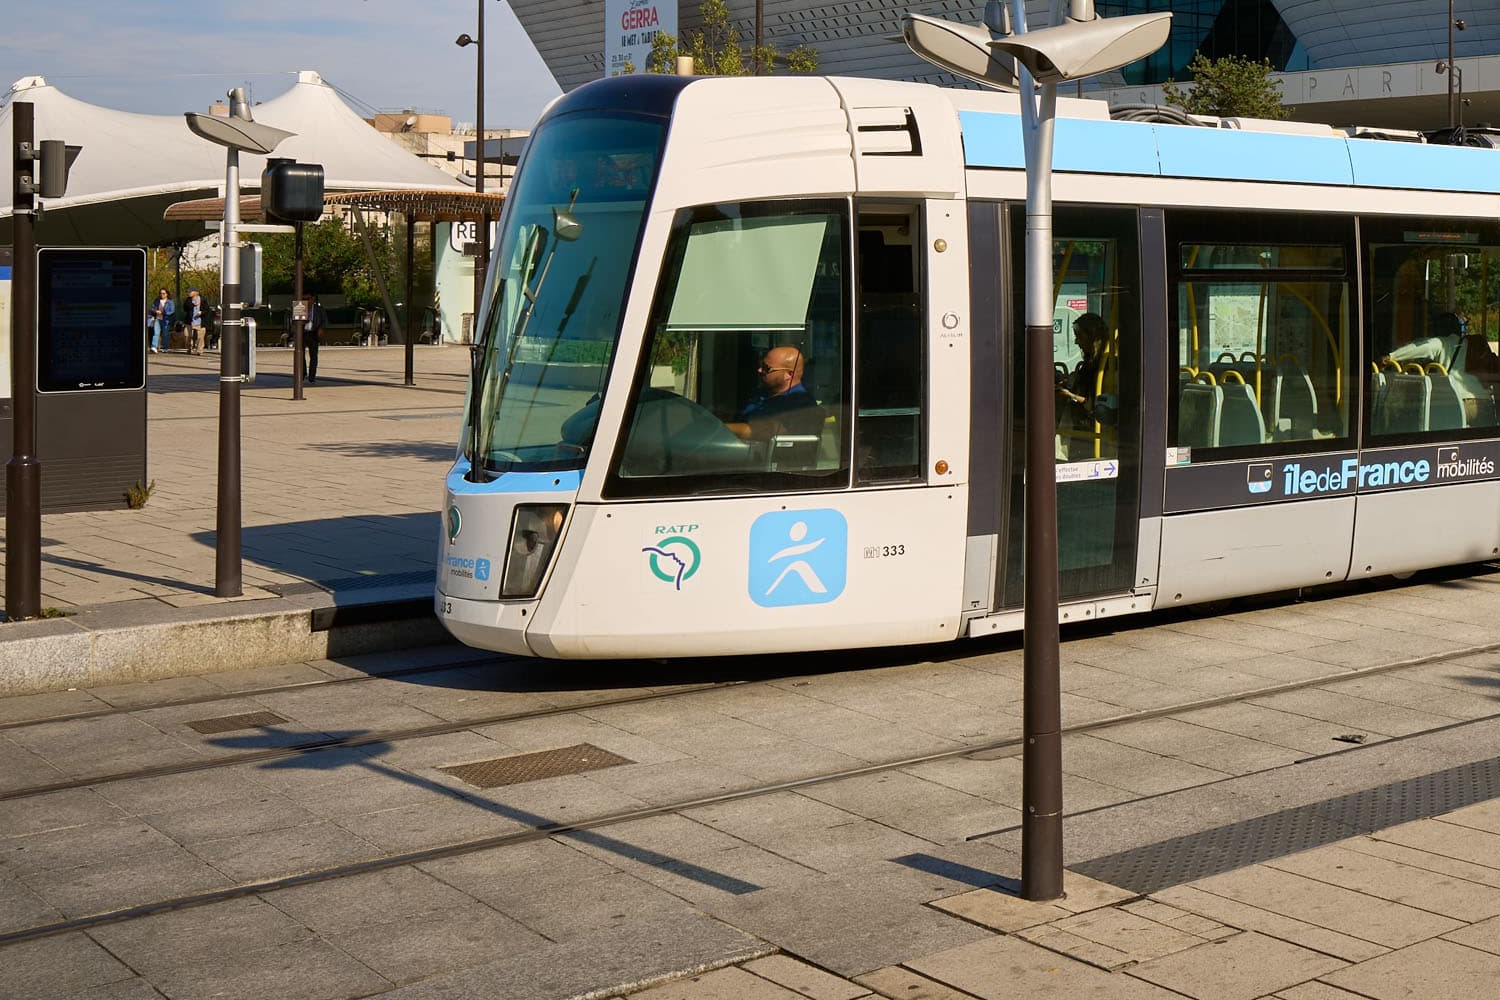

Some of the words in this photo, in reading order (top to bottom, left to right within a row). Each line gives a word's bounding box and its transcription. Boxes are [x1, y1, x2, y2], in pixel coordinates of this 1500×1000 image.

[622, 6, 659, 30] GERRA
[1436, 455, 1495, 479] mobilités
[654, 523, 700, 535] RATP
[882, 544, 905, 557] 333
